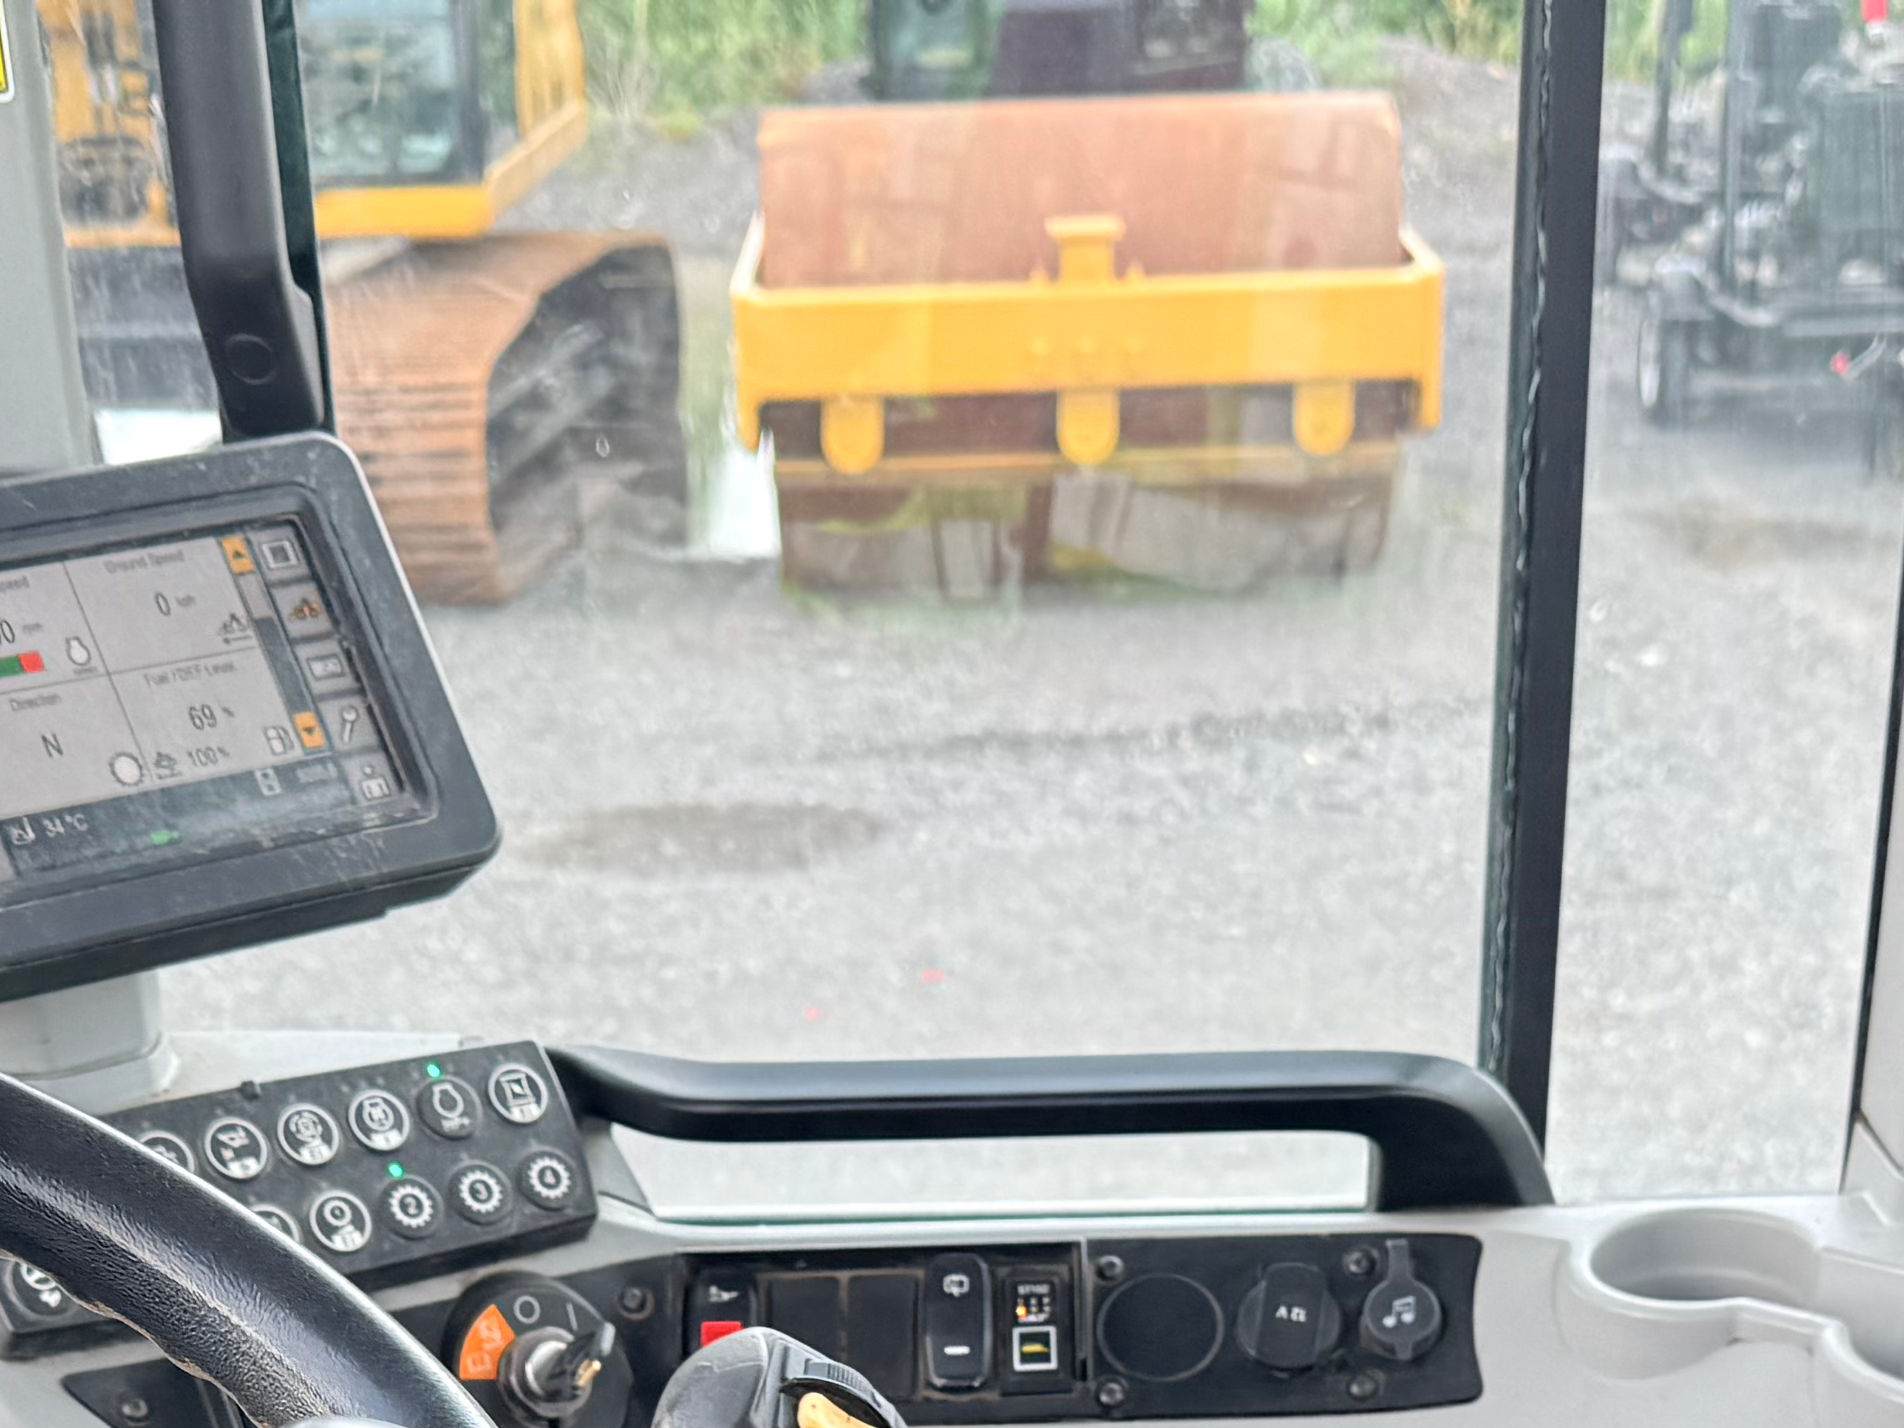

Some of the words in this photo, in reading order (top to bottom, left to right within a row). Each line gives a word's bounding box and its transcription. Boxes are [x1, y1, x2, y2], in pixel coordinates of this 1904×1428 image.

[188, 703, 217, 730] 69
[40, 732, 64, 759] N
[474, 1182, 489, 1201] 3
[404, 1196, 419, 1216] 2
